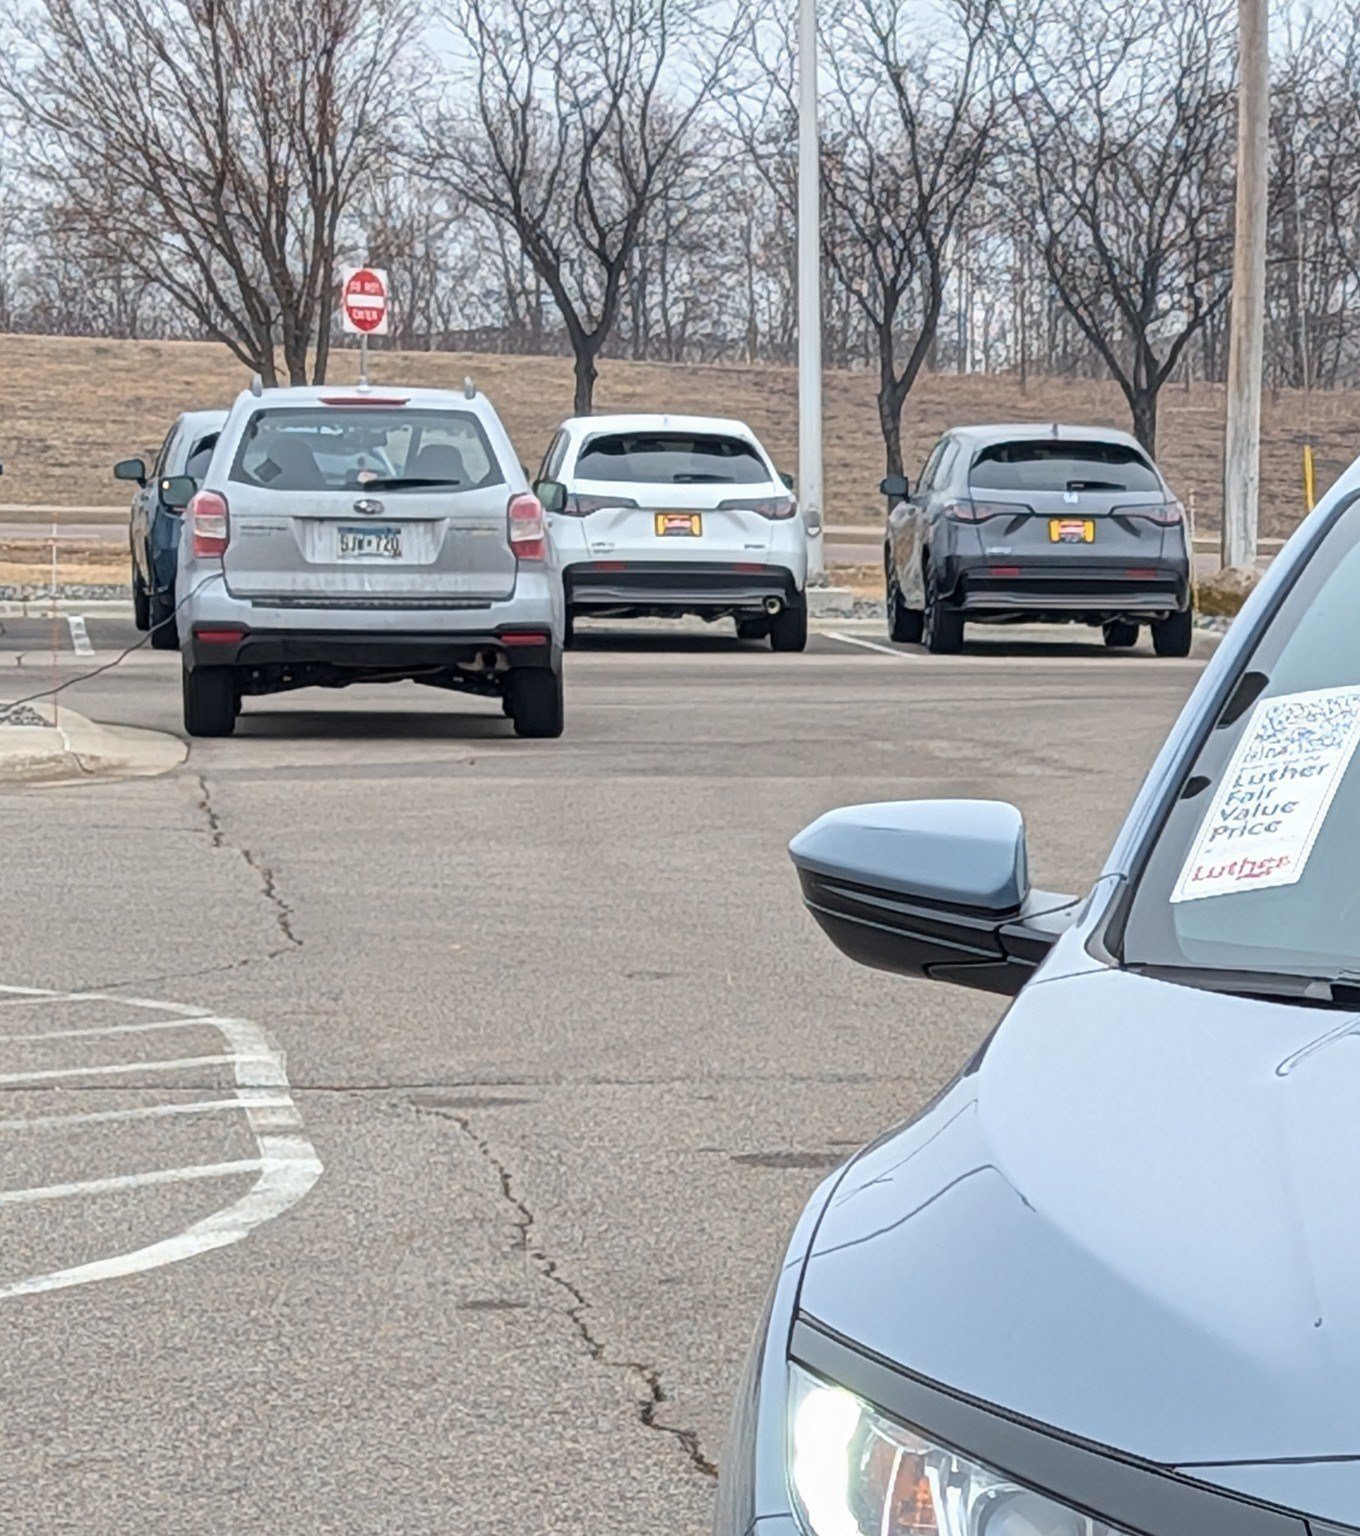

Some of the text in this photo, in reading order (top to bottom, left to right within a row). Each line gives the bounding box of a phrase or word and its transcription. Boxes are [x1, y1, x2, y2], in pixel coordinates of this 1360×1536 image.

[1233, 763, 1330, 788] Luther
[1225, 785, 1277, 806] Fair
[1221, 801, 1299, 821] Value
[1209, 820, 1282, 842] Price
